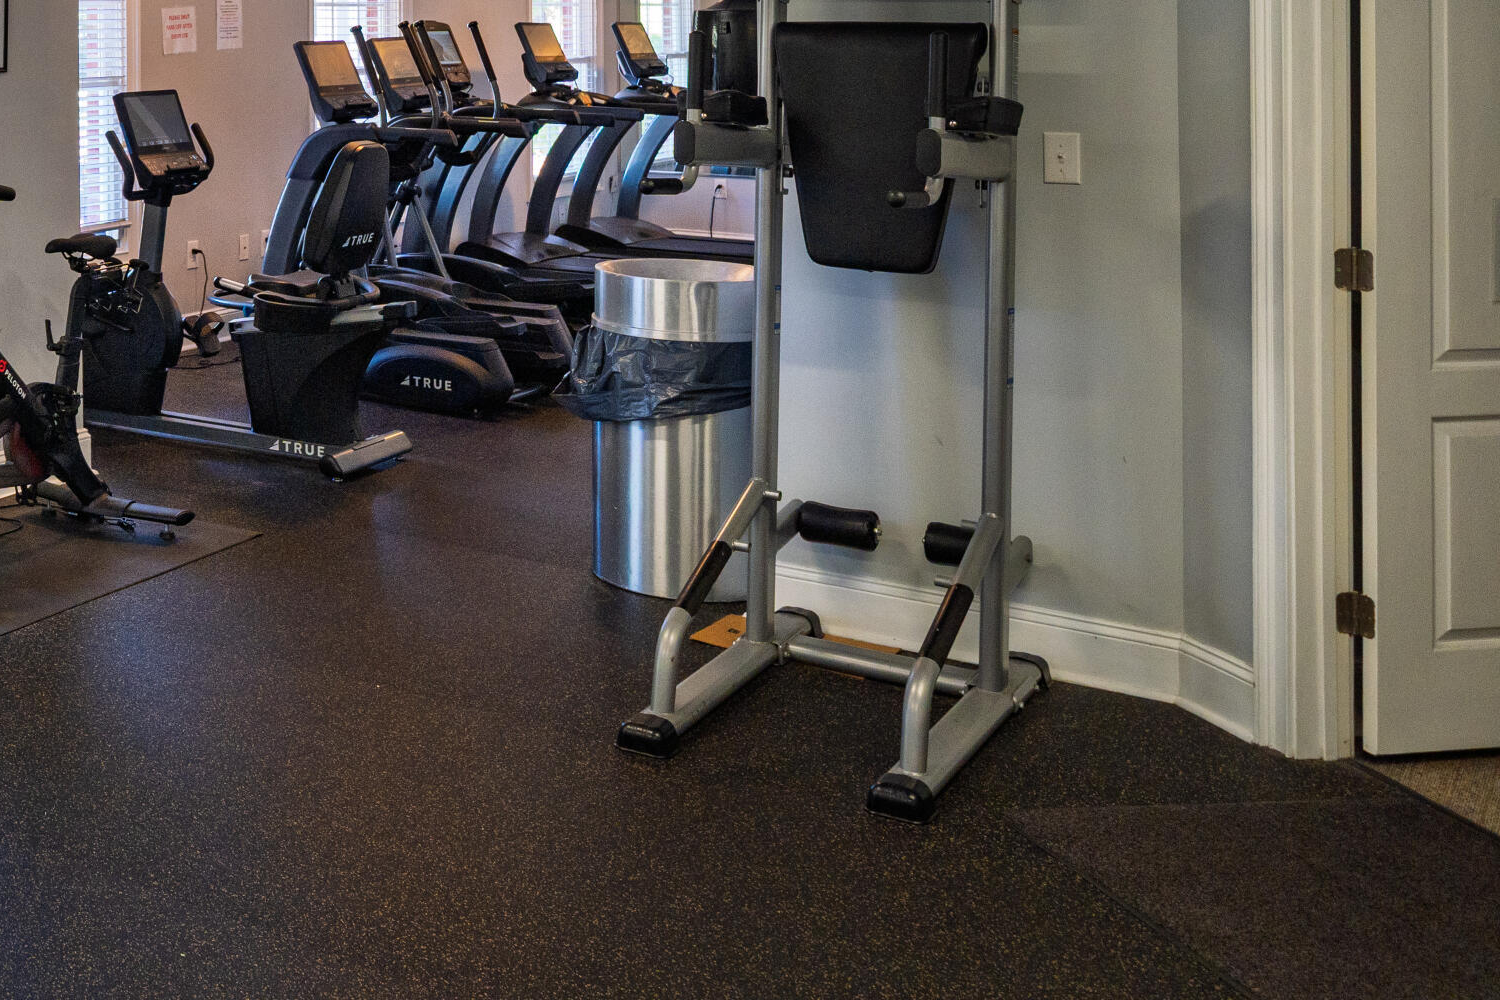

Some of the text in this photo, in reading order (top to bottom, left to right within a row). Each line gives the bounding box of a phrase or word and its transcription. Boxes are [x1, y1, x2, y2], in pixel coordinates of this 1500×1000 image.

[351, 232, 375, 246] TRUE
[4, 369, 27, 399] PELOTON
[412, 375, 452, 391] TRUE
[282, 440, 325, 457] TRUE
